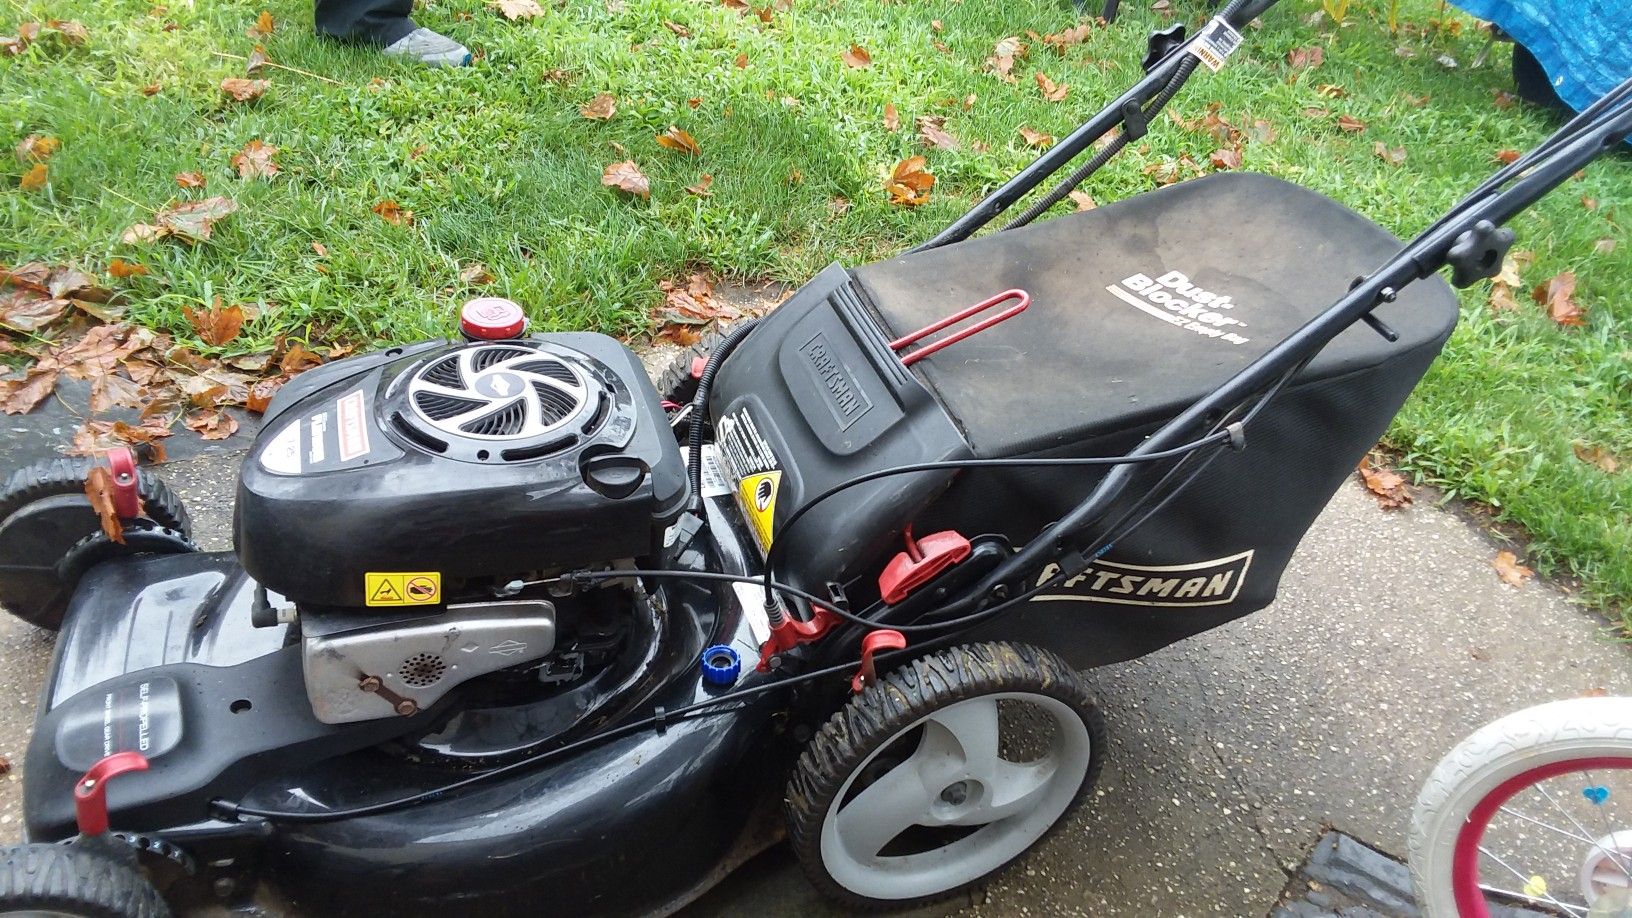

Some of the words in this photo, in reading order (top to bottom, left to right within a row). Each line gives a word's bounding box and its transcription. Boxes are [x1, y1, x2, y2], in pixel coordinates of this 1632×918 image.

[1121, 272, 1240, 327] Blocker
[808, 344, 861, 417] CRAFTSMAN
[1035, 562, 1234, 598] AFTSMAN
